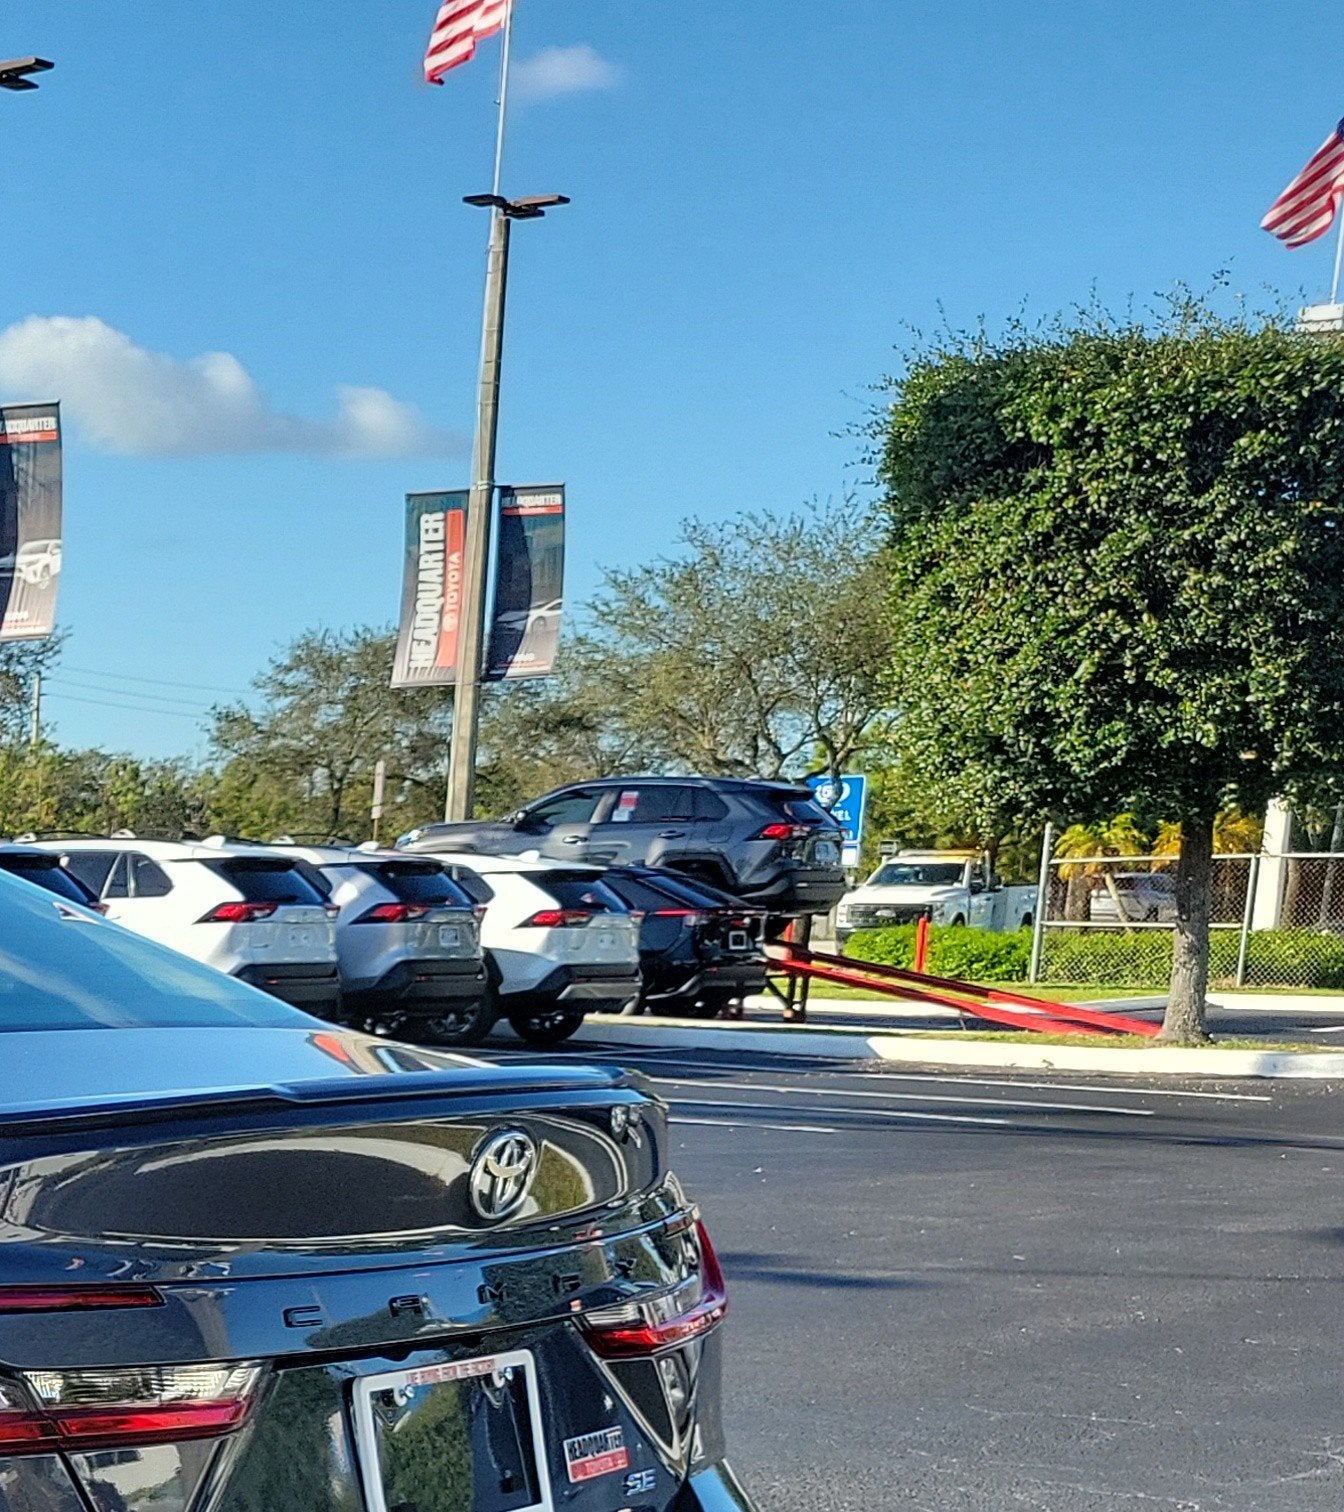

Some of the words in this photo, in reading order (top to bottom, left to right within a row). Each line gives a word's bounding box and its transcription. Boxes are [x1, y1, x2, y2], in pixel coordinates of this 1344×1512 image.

[409, 512, 444, 668] HEADQUARTER
[443, 552, 461, 616] TOYOTA
[566, 1431, 623, 1463] HEADQUARTER
[626, 1469, 657, 1496] SE
